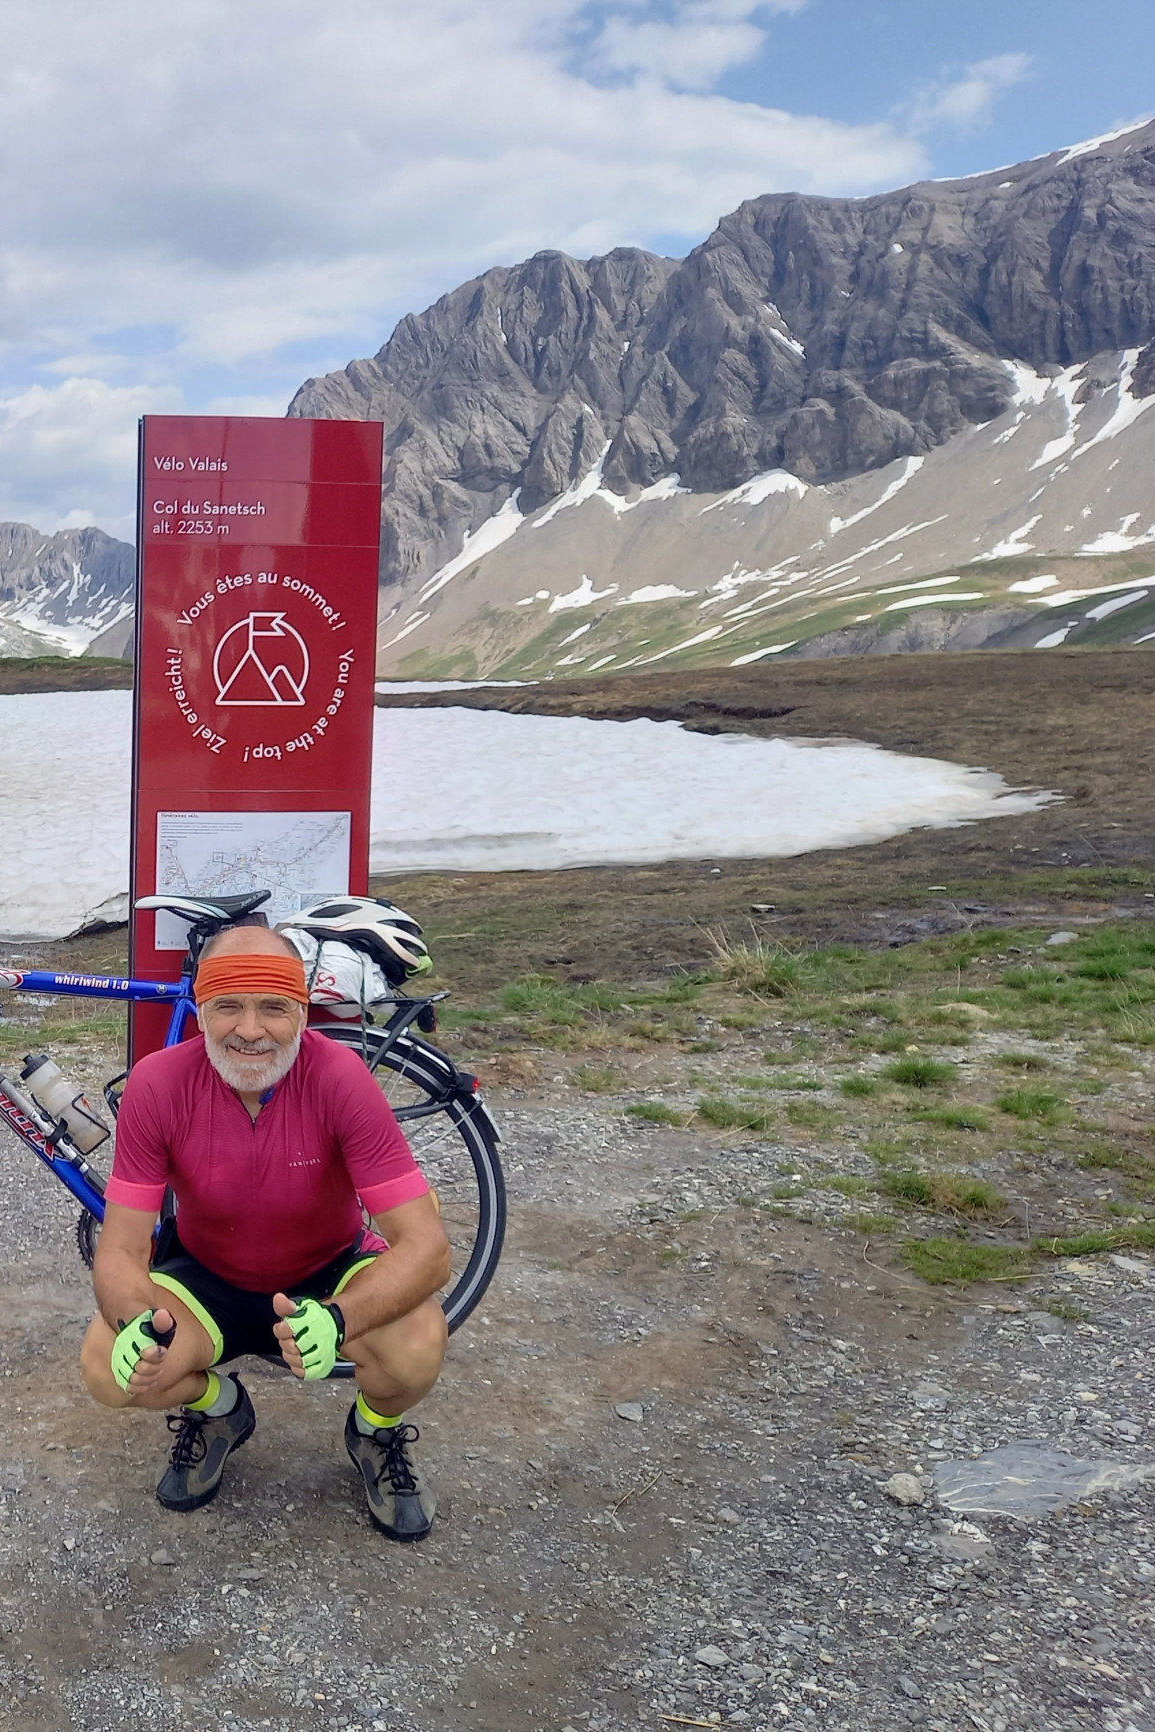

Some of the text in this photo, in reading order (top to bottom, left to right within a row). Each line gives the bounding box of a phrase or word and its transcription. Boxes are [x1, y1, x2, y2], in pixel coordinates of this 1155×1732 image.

[154, 456, 228, 471] Vélo Valais
[153, 501, 266, 515] Col du Sanetsch
[152, 520, 229, 534] alt. 2253 m
[177, 592, 215, 626] Vous
[216, 573, 253, 594] êtes
[257, 572, 278, 584] au
[337, 648, 355, 684] You
[326, 687, 346, 715] are
[311, 717, 329, 736] at
[192, 724, 227, 754] Ziel
[286, 732, 315, 752] the
[55, 975, 129, 991] whirlwind 1.0
